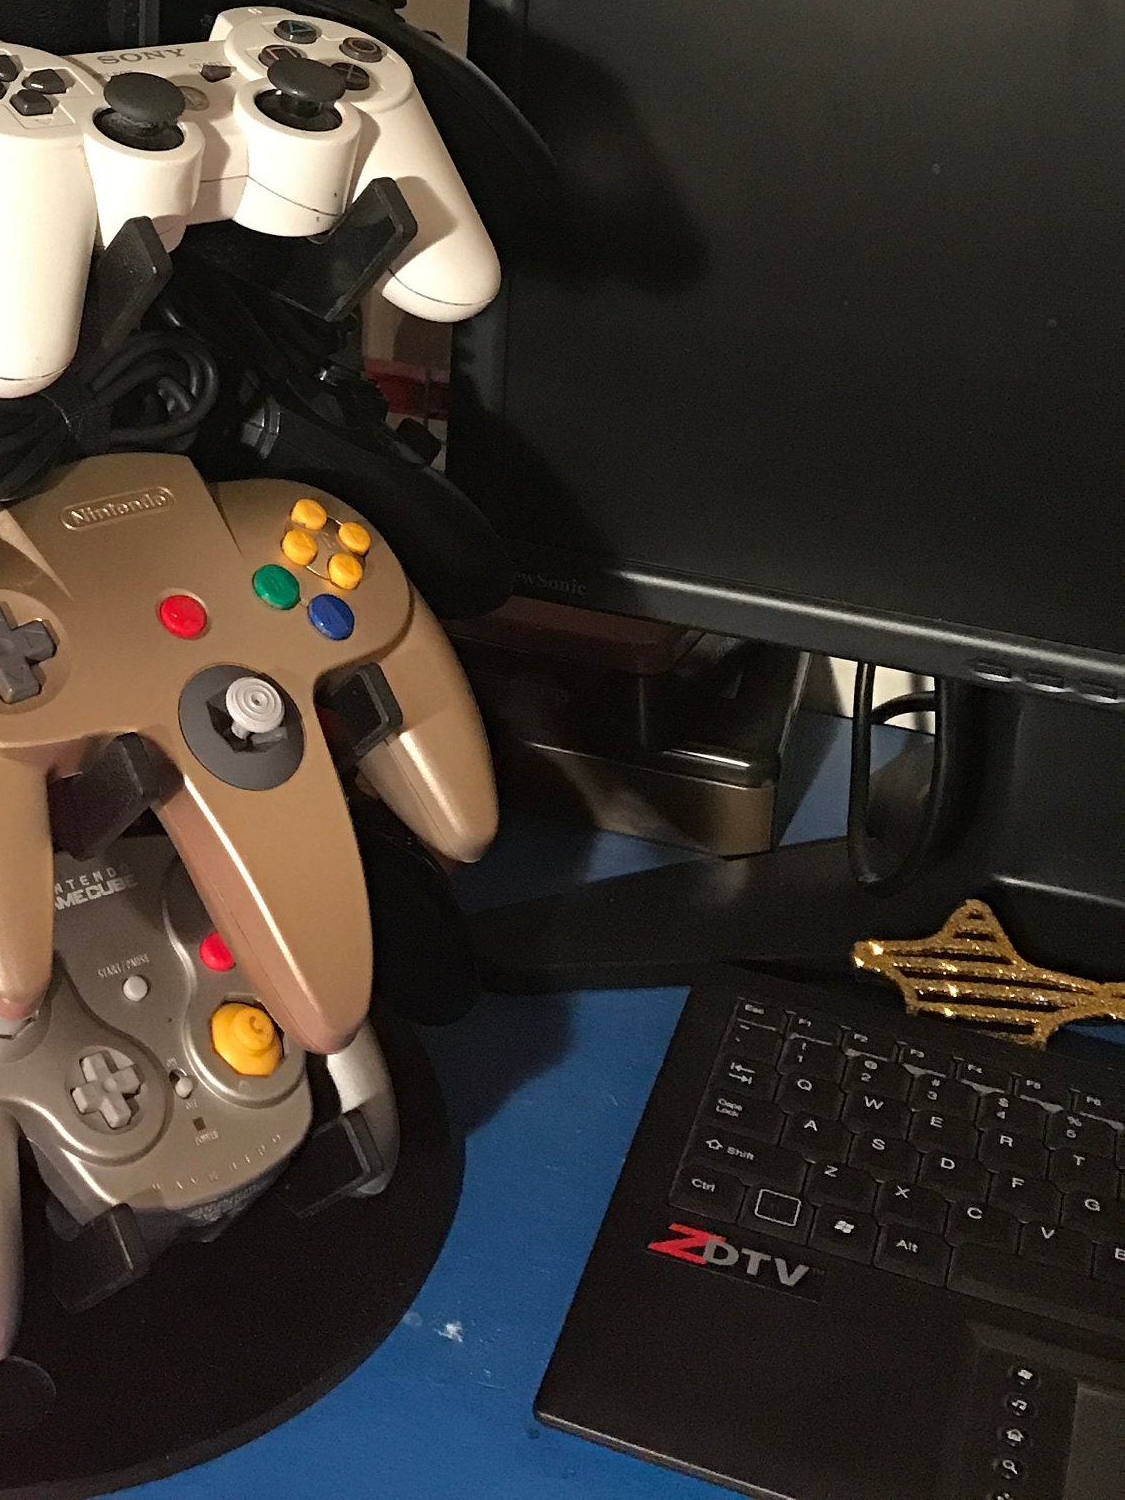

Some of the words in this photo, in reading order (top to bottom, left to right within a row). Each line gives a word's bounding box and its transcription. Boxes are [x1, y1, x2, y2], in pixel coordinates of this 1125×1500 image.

[97, 47, 186, 65] SONY
[70, 492, 167, 525] Nintendo
[860, 1072, 872, 1082] 2
[796, 1078, 813, 1092] Q
[863, 1095, 884, 1110] W
[930, 1115, 944, 1129] E
[999, 1134, 1014, 1148] R
[1072, 1154, 1086, 1167] T
[726, 1145, 755, 1161] Shift
[823, 1164, 839, 1178] Z
[894, 1184, 911, 1199] X
[966, 1206, 983, 1220] C
[1040, 1225, 1056, 1240] V
[803, 1119, 818, 1132] A
[871, 1138, 886, 1152] S
[939, 1156, 956, 1170] D
[1011, 1176, 1025, 1188] F
[1084, 1197, 1101, 1212] G
[691, 1177, 716, 1193] Ctrl
[895, 1238, 919, 1254] Alt
[646, 1221, 811, 1287] ZDTV
